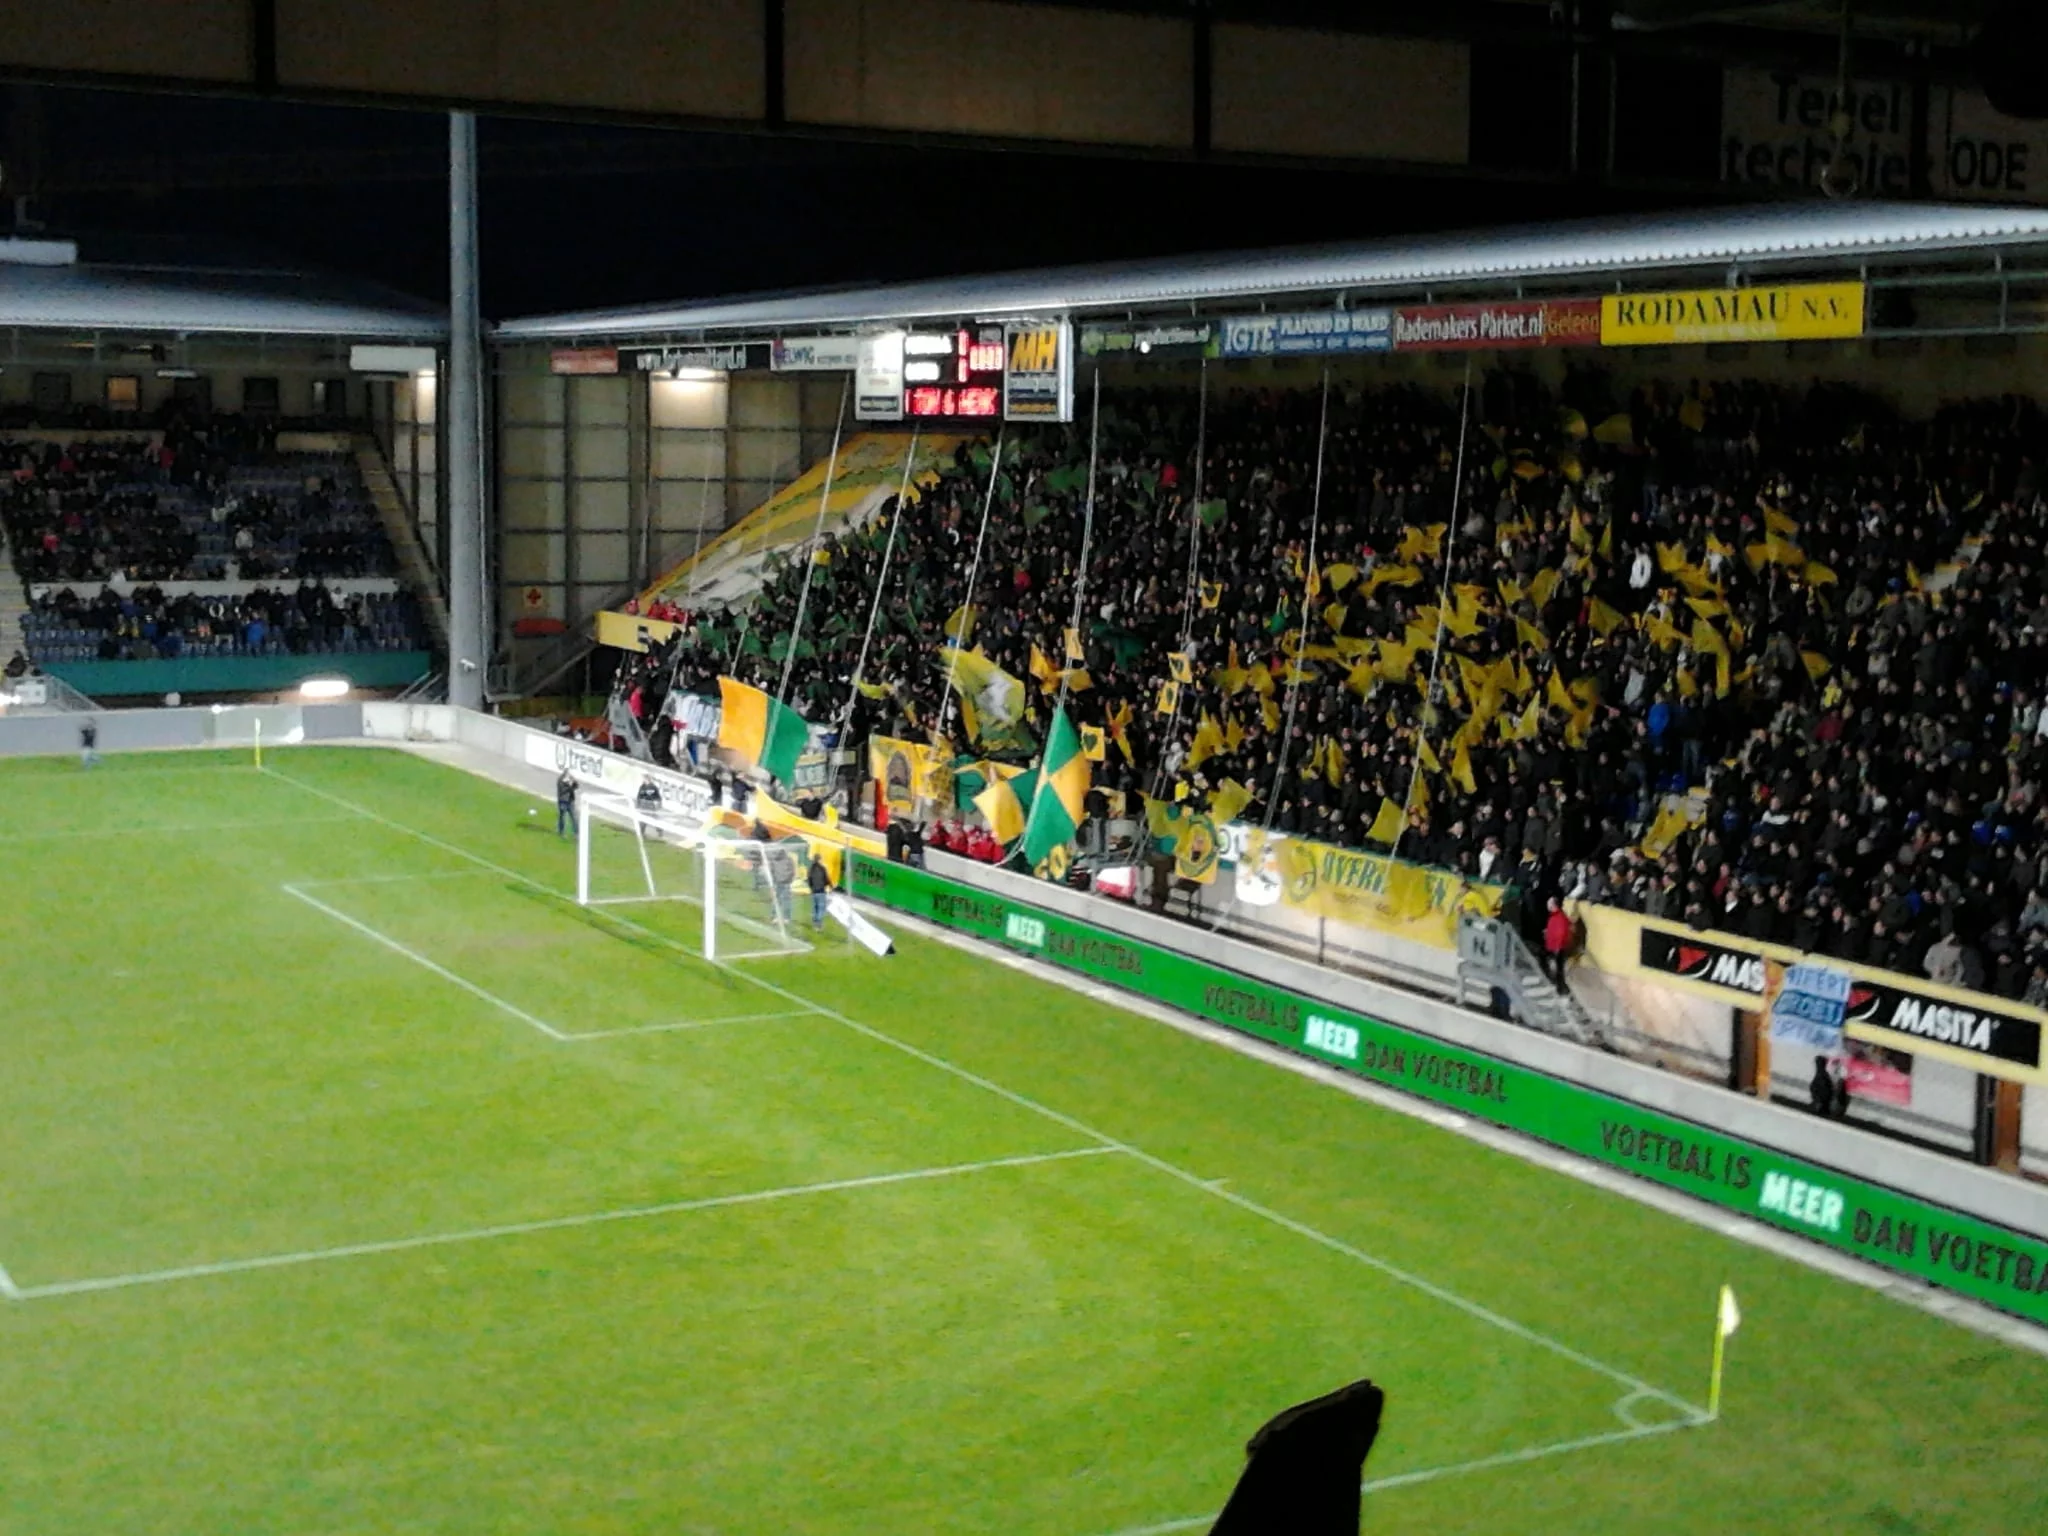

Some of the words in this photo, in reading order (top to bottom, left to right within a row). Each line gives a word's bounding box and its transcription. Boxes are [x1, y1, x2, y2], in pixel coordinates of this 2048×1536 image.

[1396, 312, 1478, 343] Rademakers
[1616, 291, 1791, 326] RODAMAU
[1711, 953, 1766, 993] MAS
[1203, 984, 1277, 1026] VOETBAL
[1281, 1000, 1298, 1032] IS
[1304, 1014, 1360, 1059] MEER
[1364, 1039, 1405, 1075] DAN
[1412, 1051, 1509, 1102] VOETBAL
[1890, 997, 1992, 1052] MASITA
[1601, 1120, 1715, 1182] VOETBAL
[1722, 1153, 1752, 1190] IS
[1759, 1171, 1846, 1232] MEER
[1853, 1207, 1917, 1257] DAN
